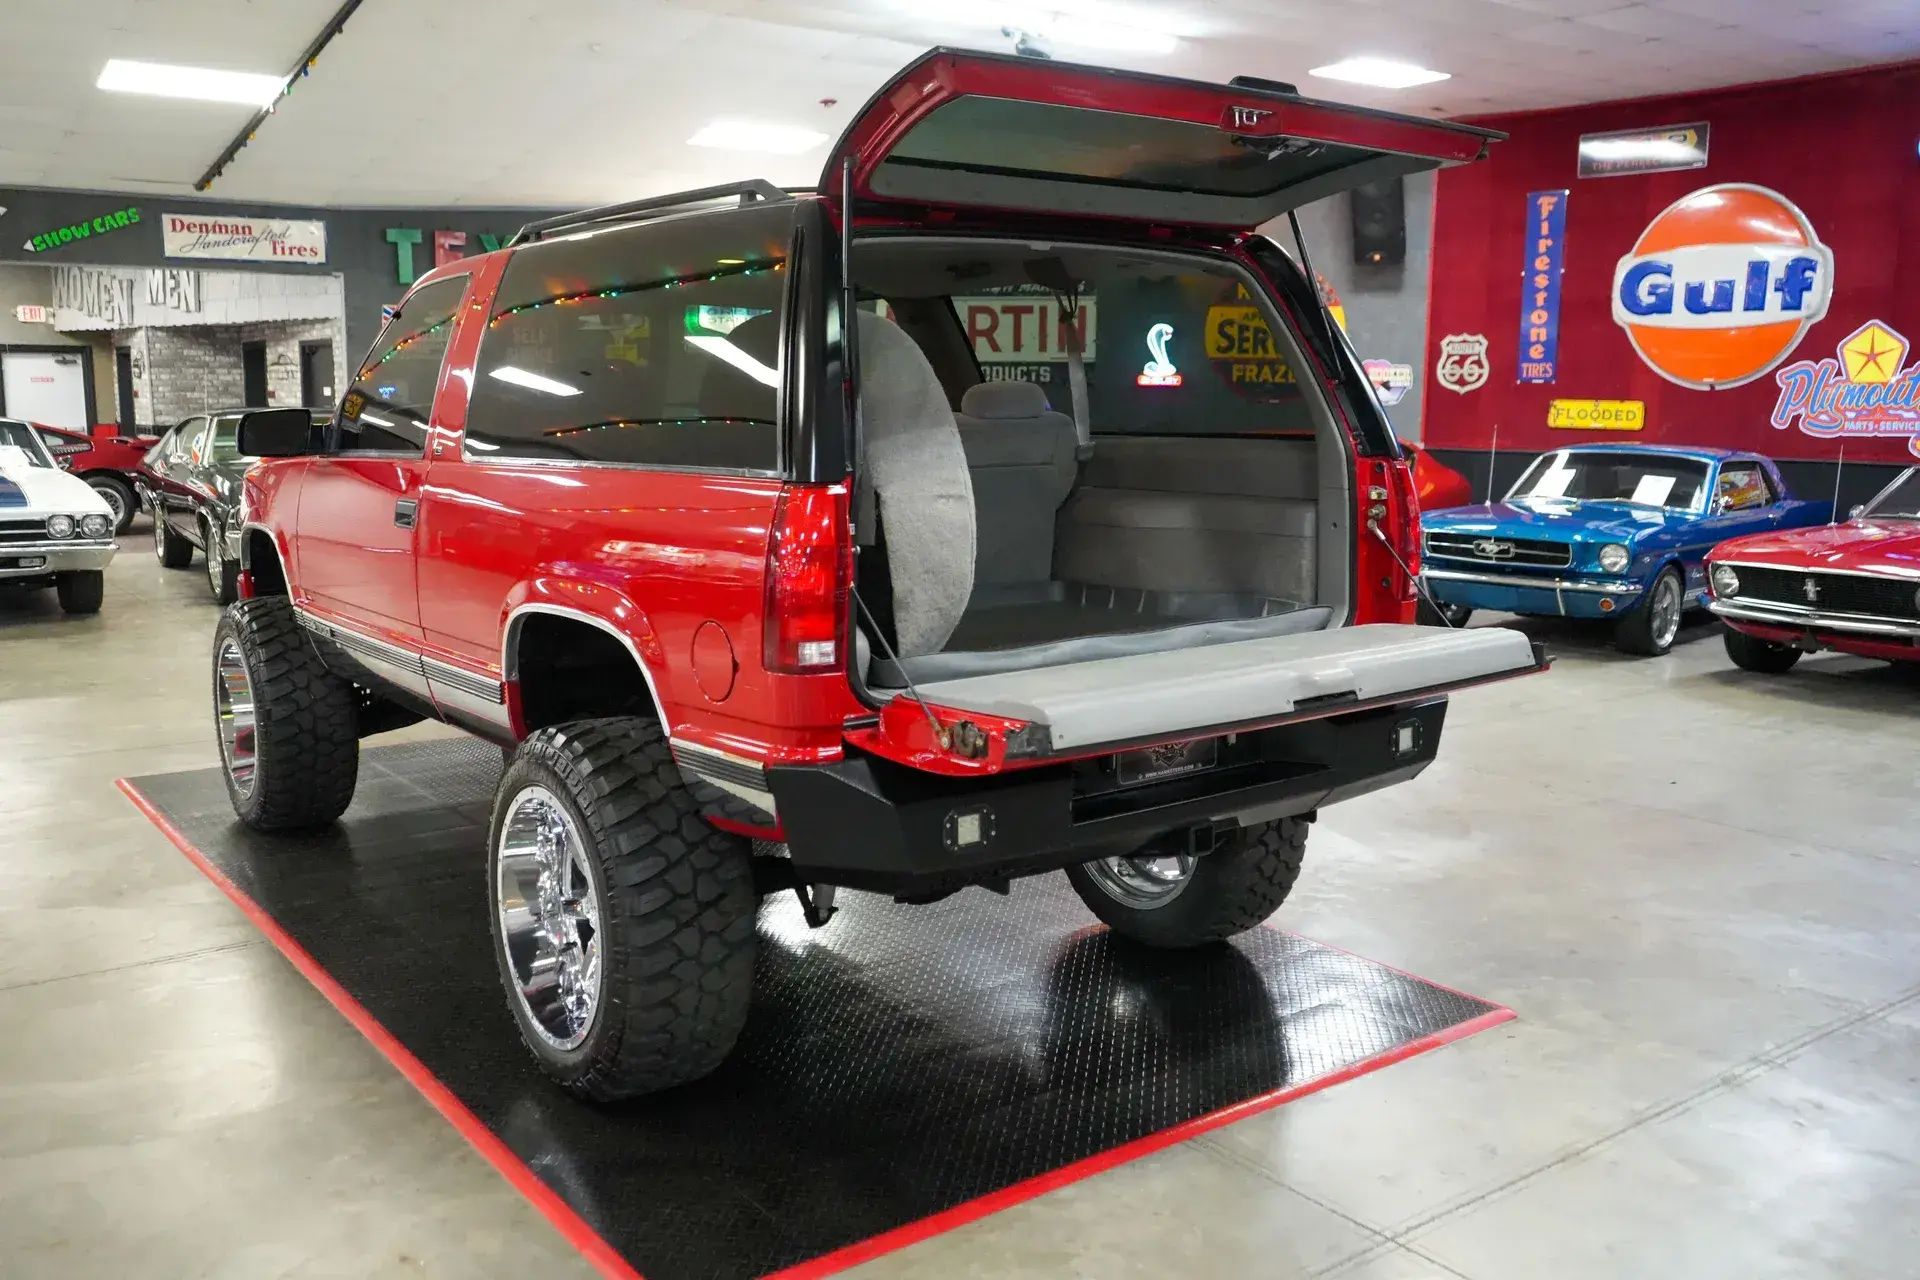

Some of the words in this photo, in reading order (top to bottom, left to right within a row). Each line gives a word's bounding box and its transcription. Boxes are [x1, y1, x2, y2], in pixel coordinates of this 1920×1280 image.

[32, 221, 91, 252] SHOW
[93, 207, 140, 234] CARS
[170, 217, 253, 236] Denman
[271, 240, 318, 257] Tires
[52, 265, 134, 326] WOMEN
[145, 268, 201, 313] MEN
[1529, 196, 1558, 359] Firestone
[1619, 256, 1819, 316] Gulf
[22, 306, 42, 321] EXIT
[967, 304, 1088, 354] RTIN
[1445, 355, 1480, 383] 66
[1522, 362, 1553, 379] TIRES
[1554, 406, 1637, 423] FLOODED
[1779, 364, 1920, 430] Plymout
[1844, 420, 1873, 431] PARTS
